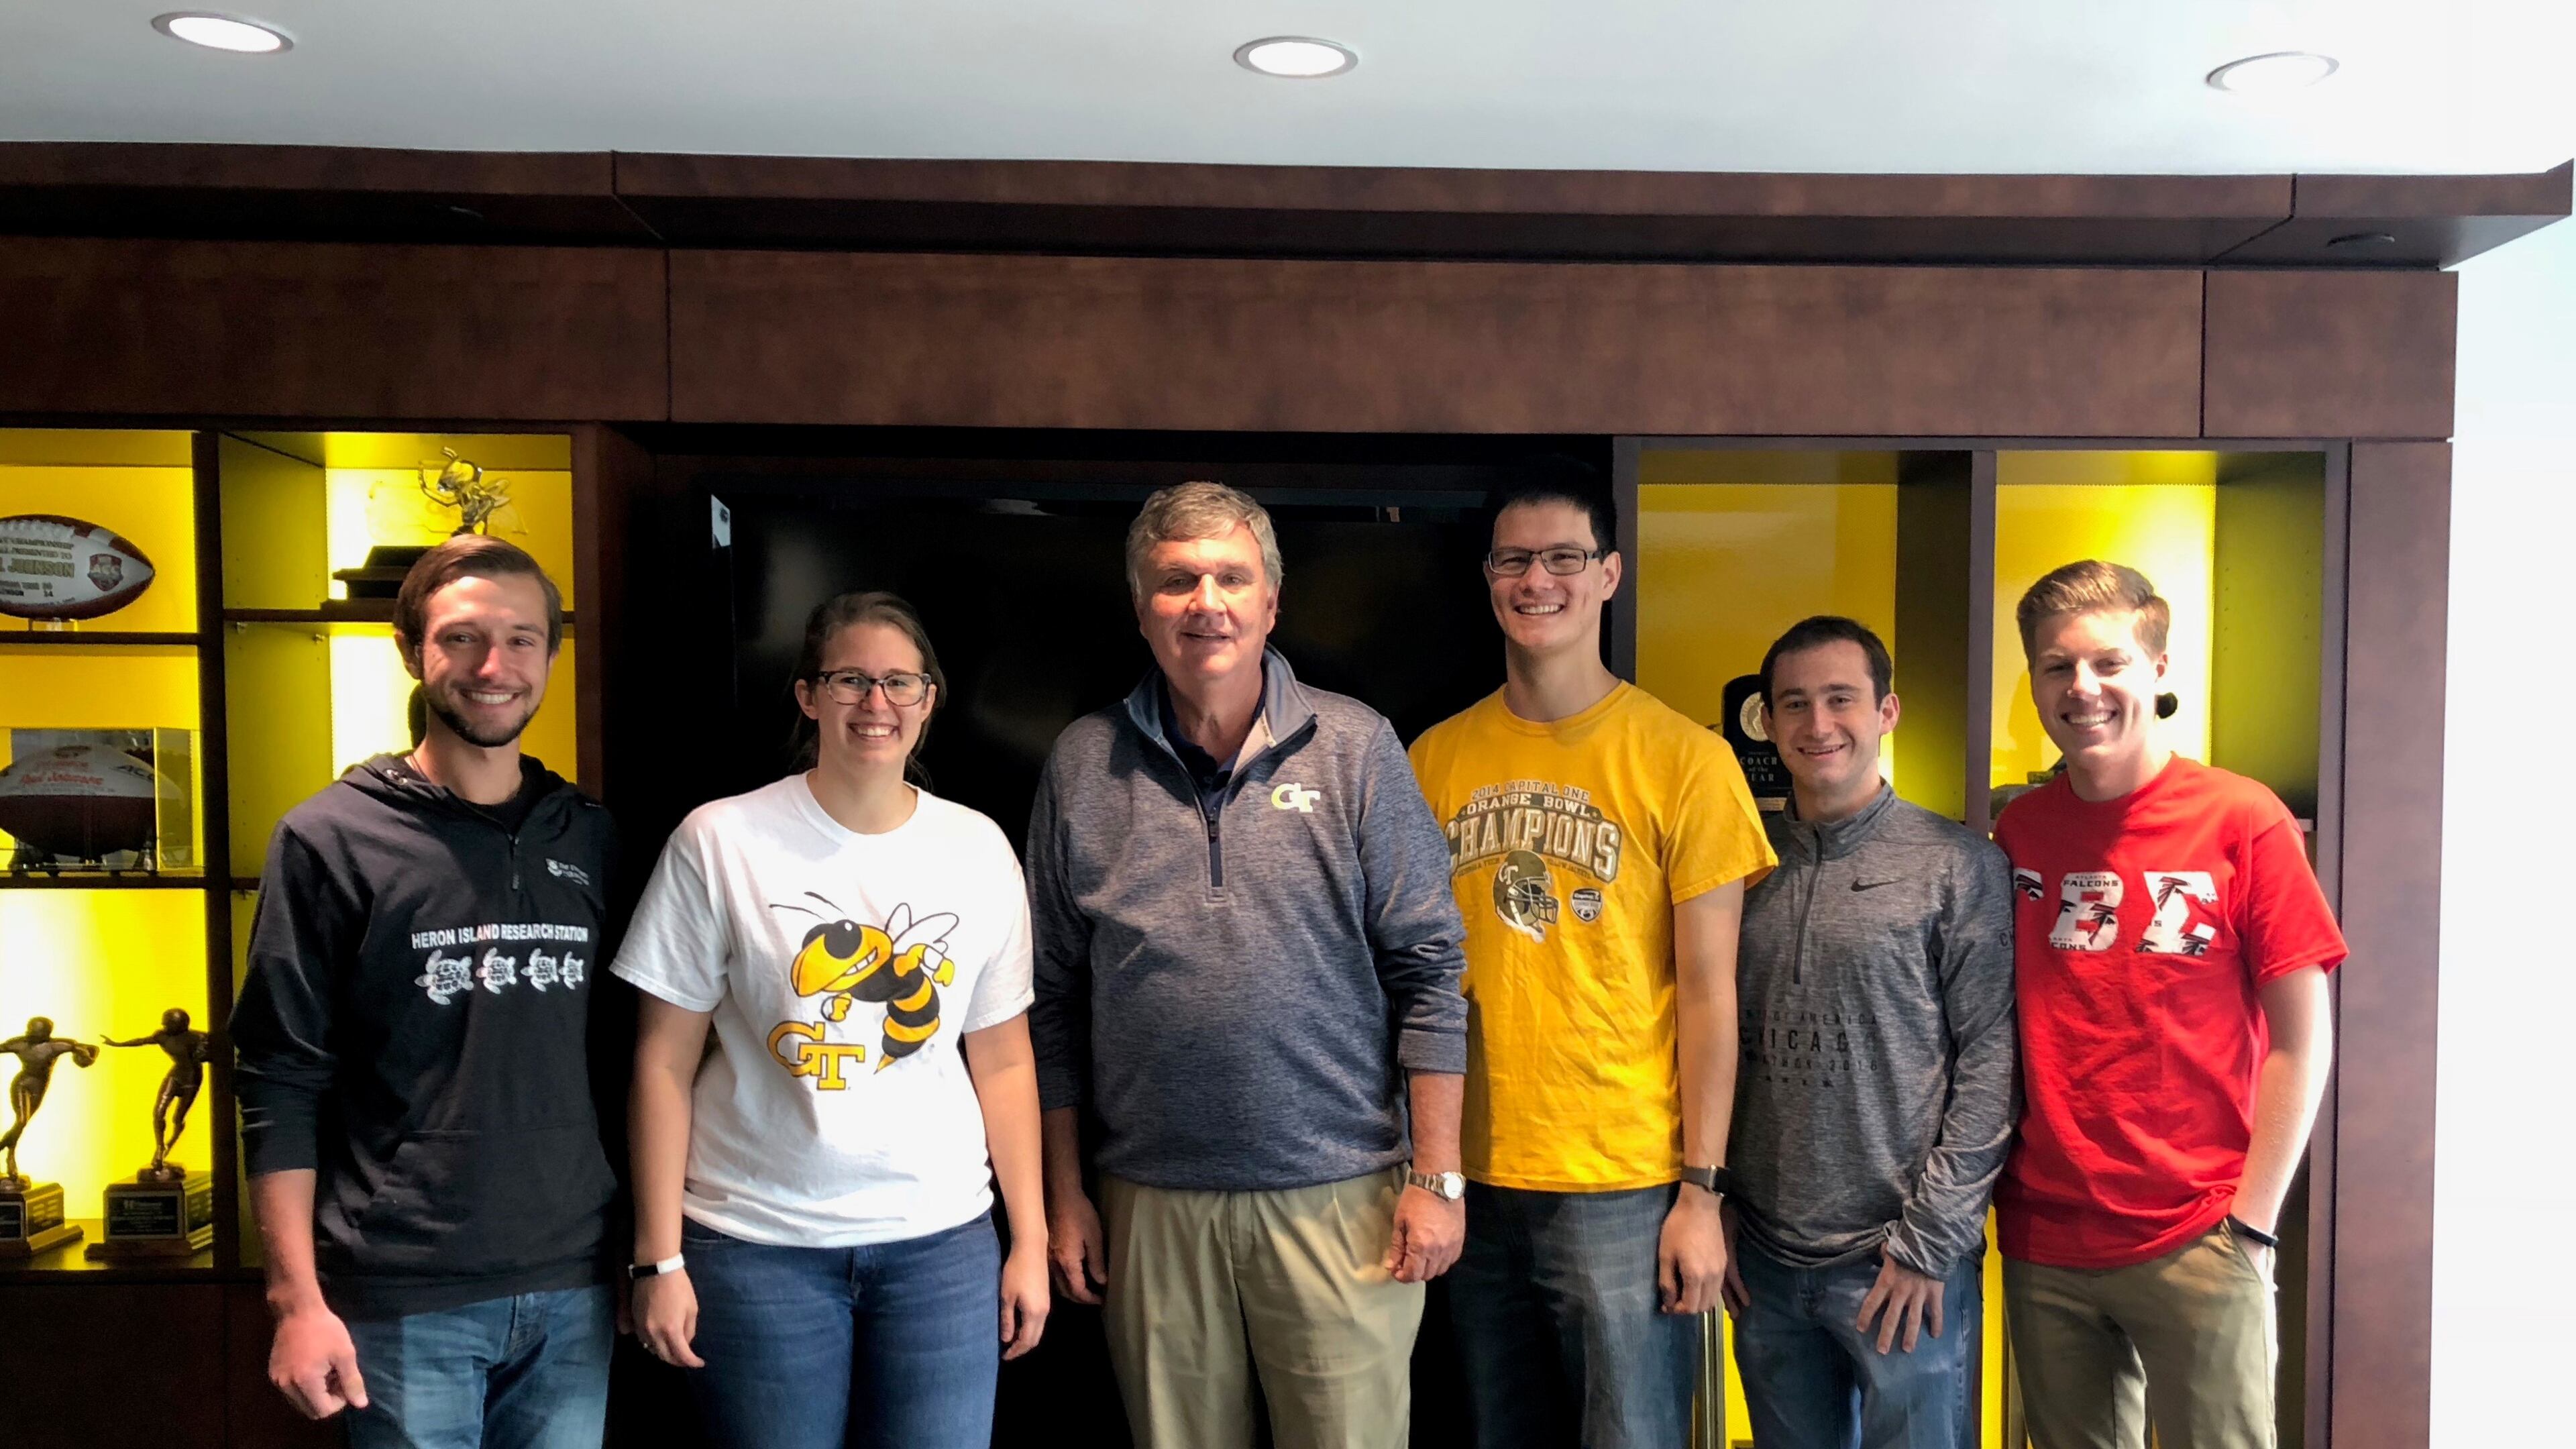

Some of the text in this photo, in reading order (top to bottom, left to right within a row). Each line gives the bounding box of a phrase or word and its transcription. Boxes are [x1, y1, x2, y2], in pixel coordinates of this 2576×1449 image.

[7, 557, 75, 578] JOHNSON
[1739, 757, 1778, 765] COACH
[1751, 773, 1774, 782] EAR
[1470, 780, 1590, 804] 2014 CAPITAL ONE
[1466, 793, 1591, 818] ORANGE BOWL
[1445, 806, 1622, 884] CHAMPIONS
[2063, 879, 2120, 888] FALCONS
[411, 922, 589, 949] HERON ISLAND RESEARCH STATION
[767, 1020, 865, 1091] GT
[1829, 1059, 1878, 1072] 2016
